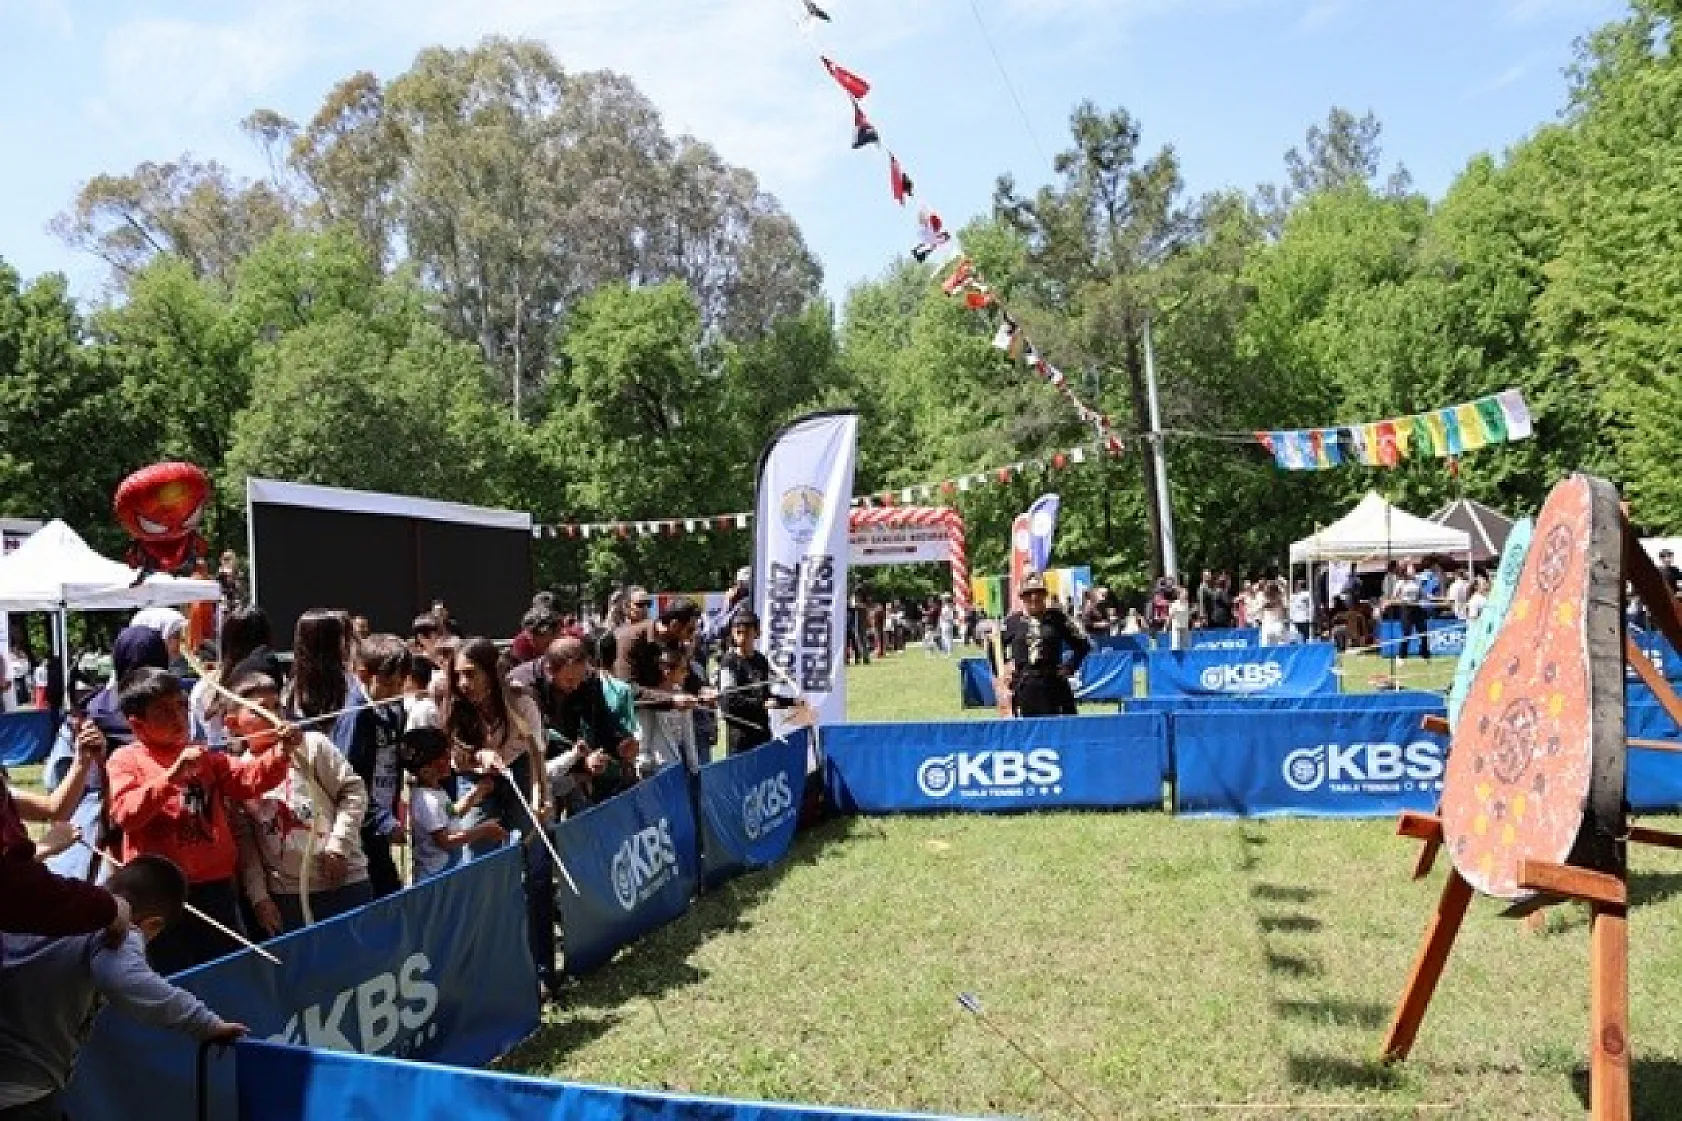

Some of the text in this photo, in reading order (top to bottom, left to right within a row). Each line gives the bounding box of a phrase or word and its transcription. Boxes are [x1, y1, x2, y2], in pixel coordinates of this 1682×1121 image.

[1225, 662, 1281, 684] KBS
[958, 748, 1061, 785] KBS
[1329, 742, 1443, 780] KBS
[760, 771, 792, 817] KBS
[631, 818, 676, 886] KBS
[304, 953, 439, 1054] KBS
